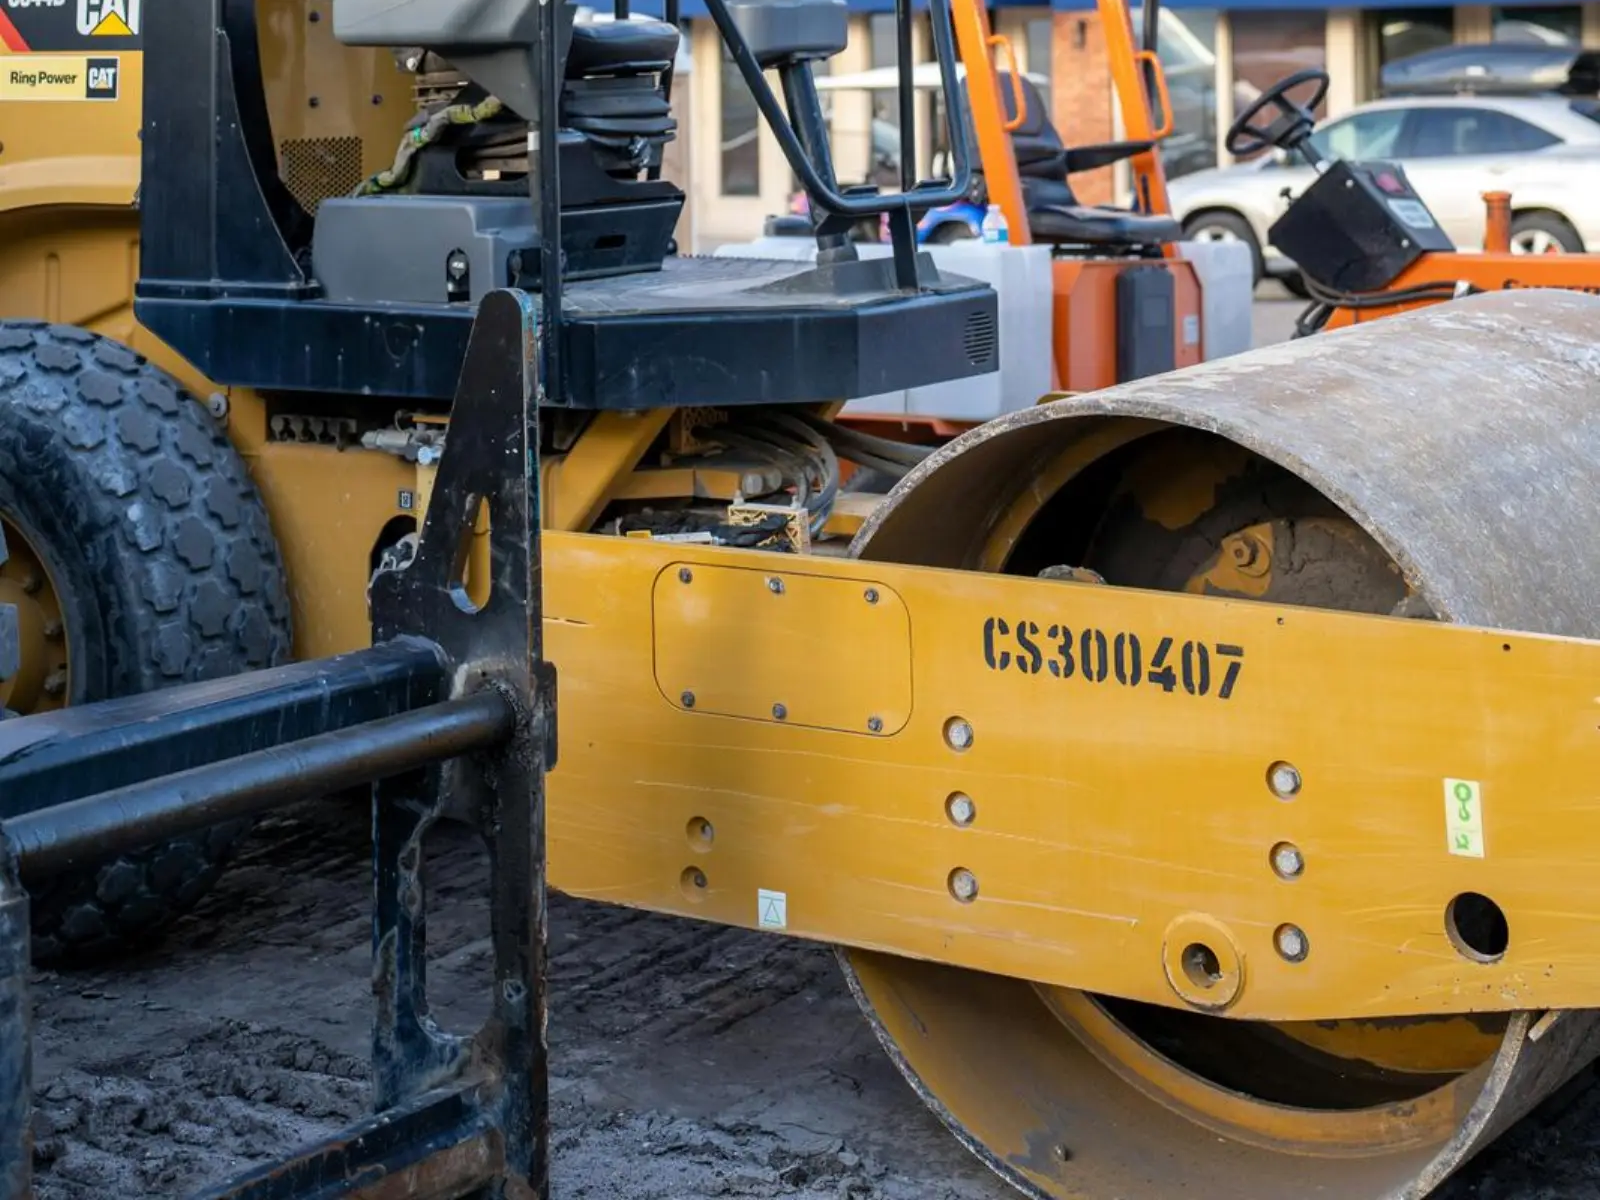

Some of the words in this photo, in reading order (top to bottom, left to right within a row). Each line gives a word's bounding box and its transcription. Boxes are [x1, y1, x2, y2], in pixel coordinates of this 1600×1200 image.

[10, 71, 37, 87] Ring
[38, 71, 78, 85] Power
[88, 67, 116, 89] CAT
[983, 617, 1244, 699] CS300407
